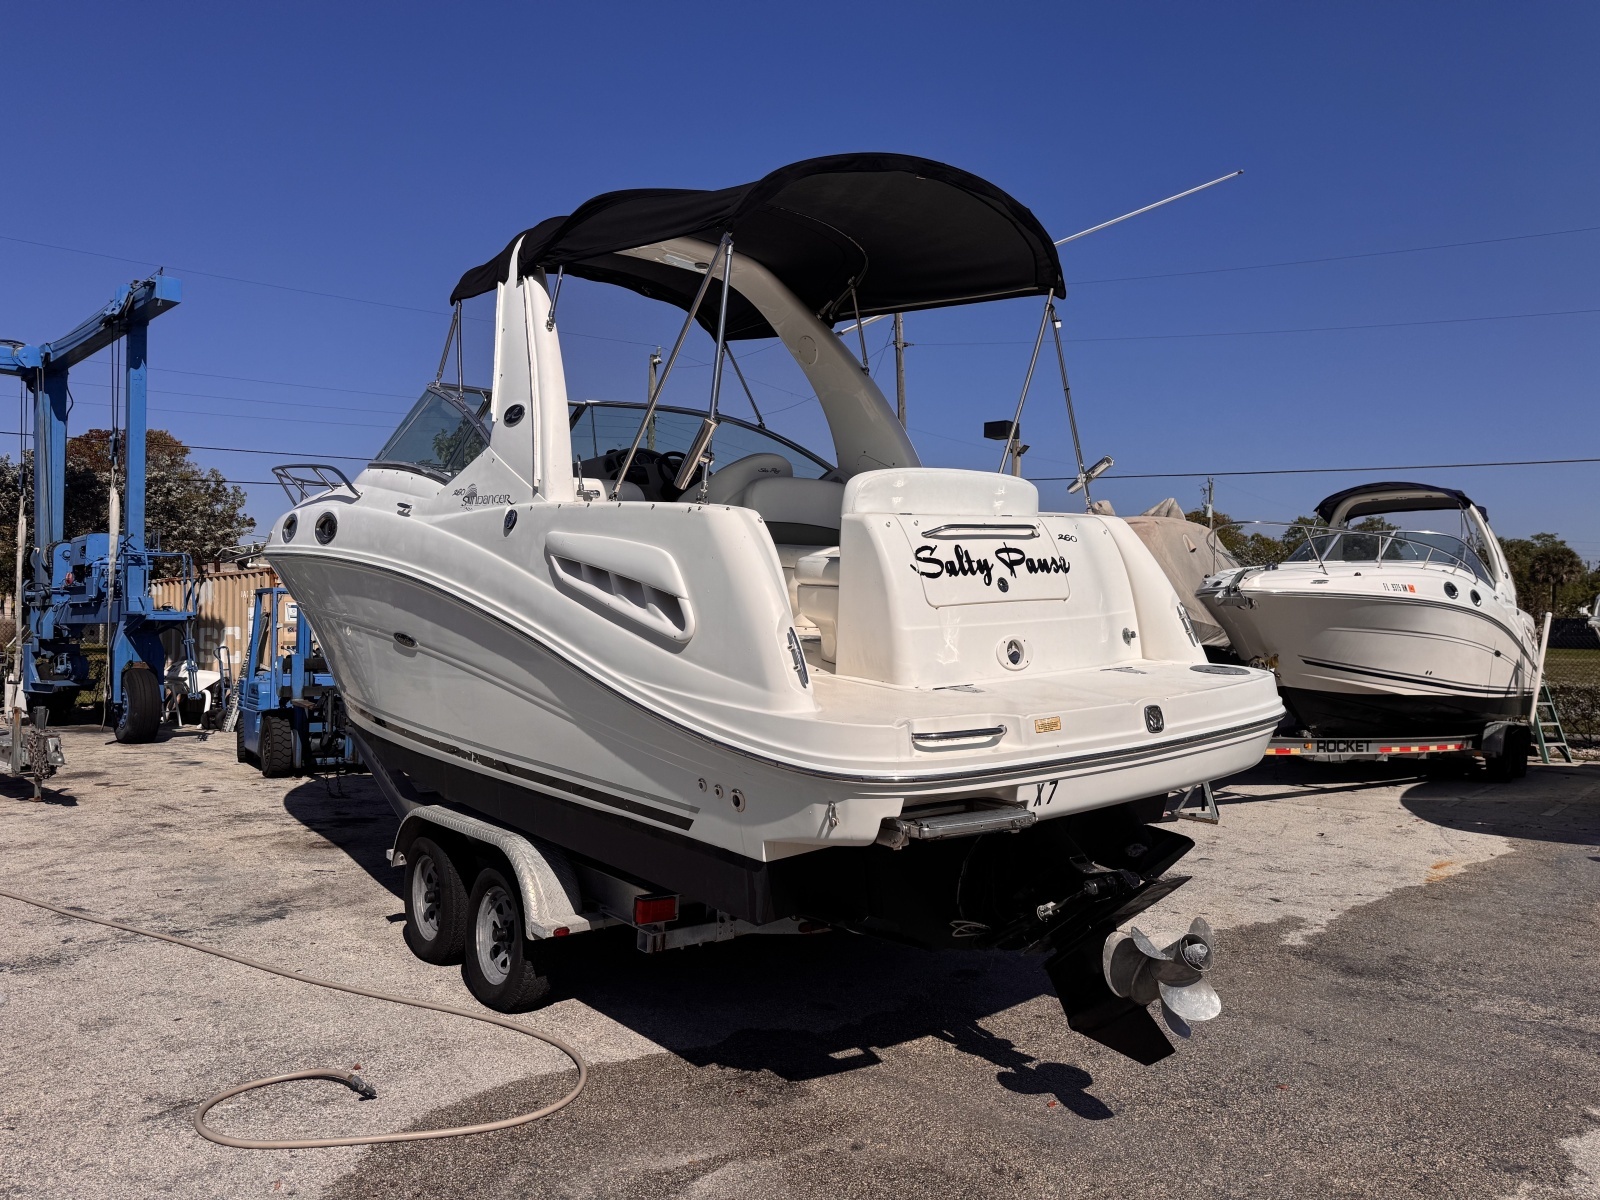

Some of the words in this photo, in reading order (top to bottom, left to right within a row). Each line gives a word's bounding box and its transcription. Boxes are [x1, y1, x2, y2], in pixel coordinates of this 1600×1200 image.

[1057, 533, 1078, 543] 260
[910, 544, 994, 586] Salty
[994, 541, 1070, 579] Pause
[1316, 739, 1373, 753] ROCKET
